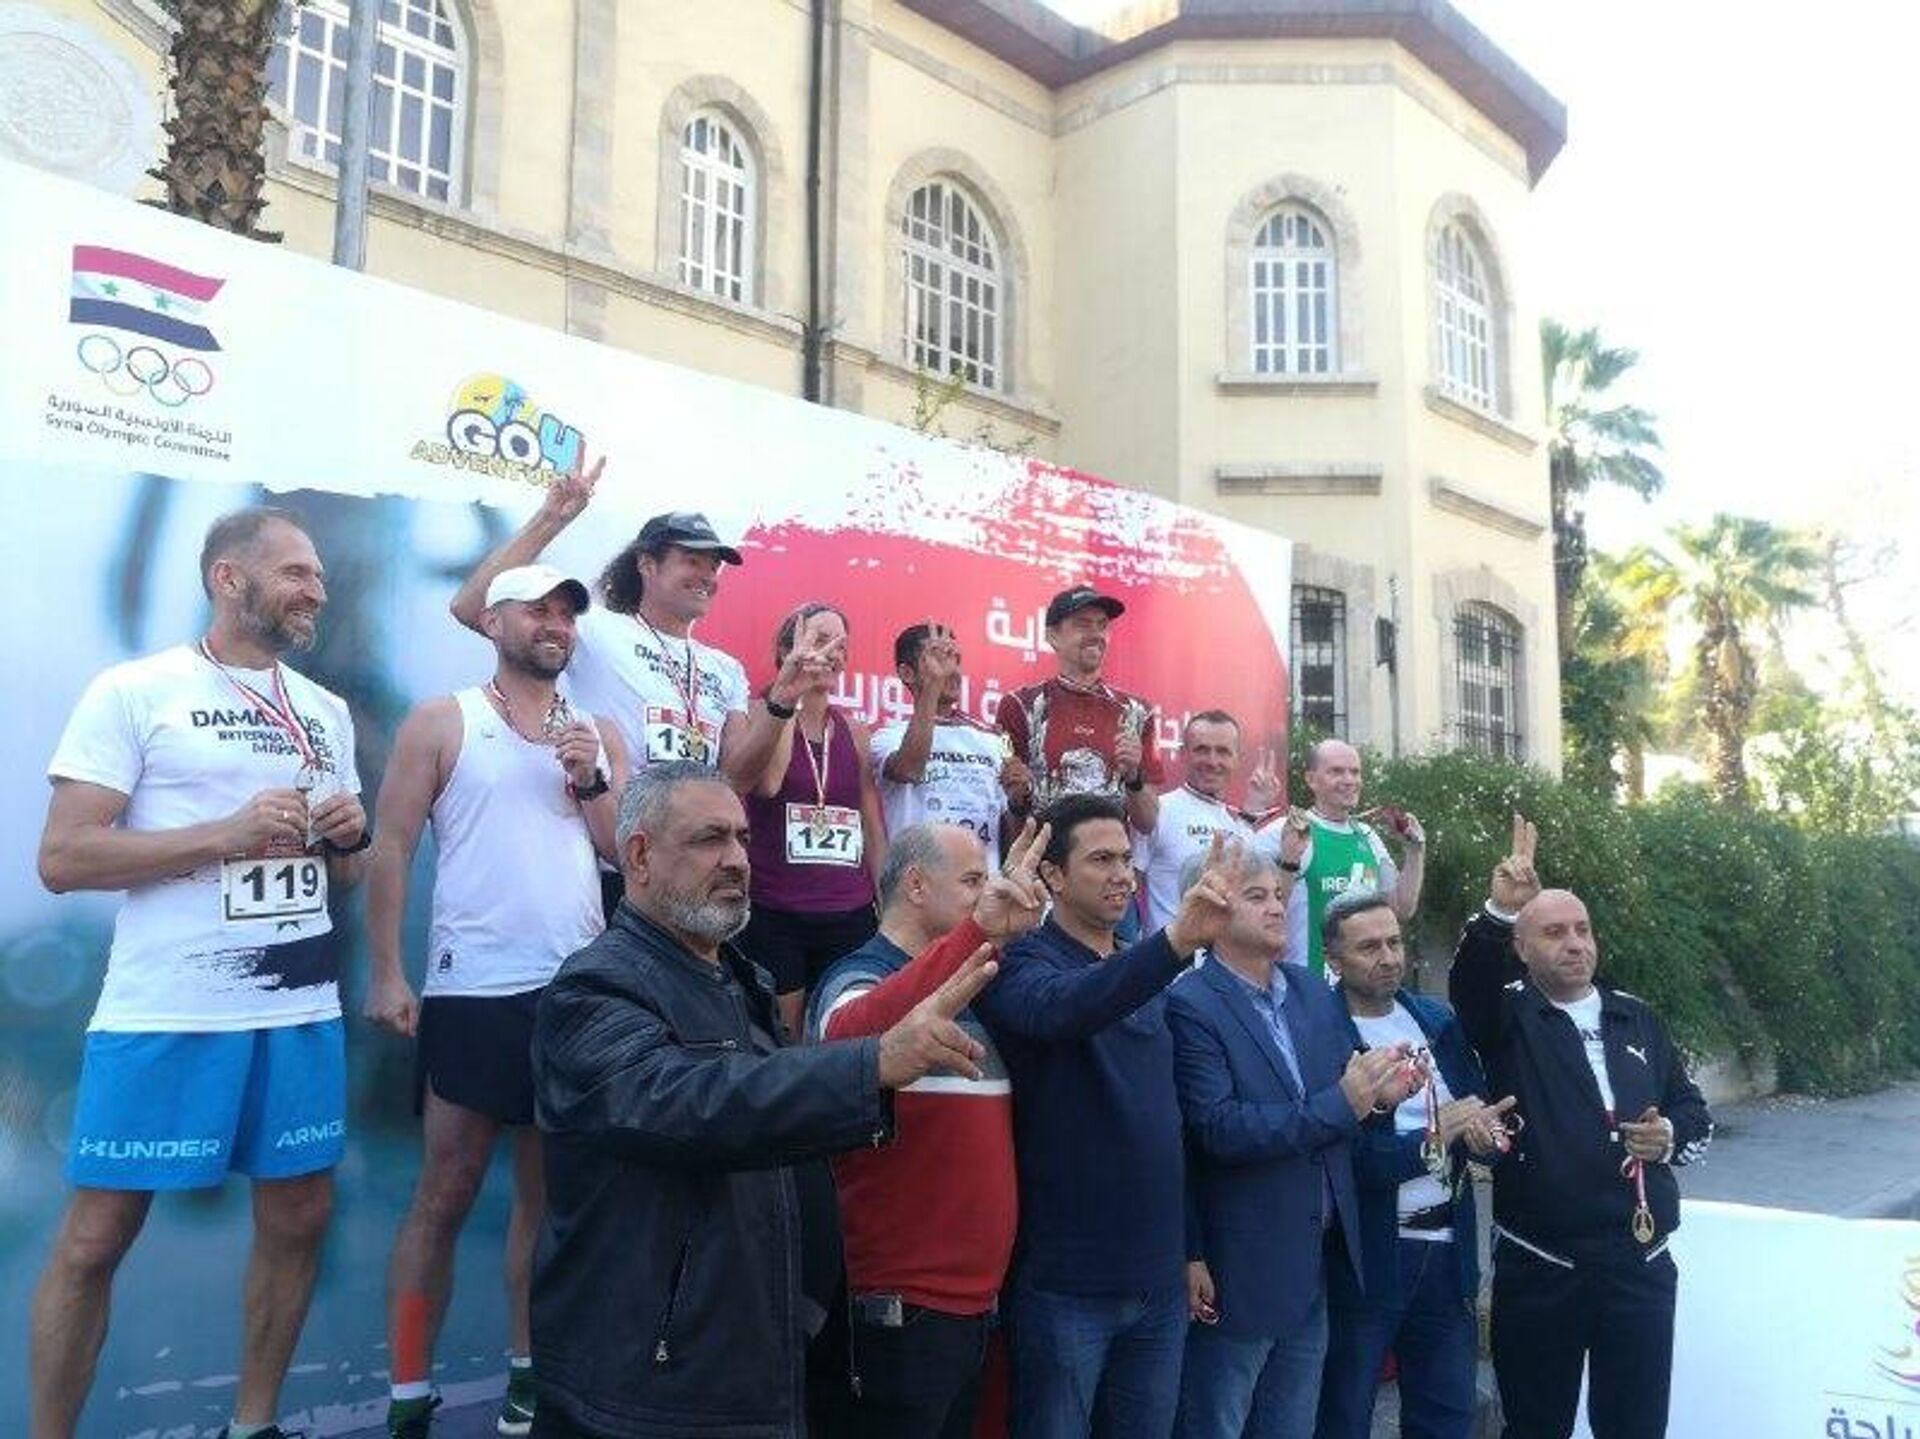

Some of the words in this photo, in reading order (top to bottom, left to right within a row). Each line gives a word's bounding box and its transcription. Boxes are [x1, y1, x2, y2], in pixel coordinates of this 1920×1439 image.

[45, 412, 83, 432] Syria
[86, 420, 150, 447] Olympic
[153, 434, 231, 462] Committee
[798, 826, 852, 852] 127
[242, 862, 319, 902] 119
[109, 1138, 220, 1159] UNDER
